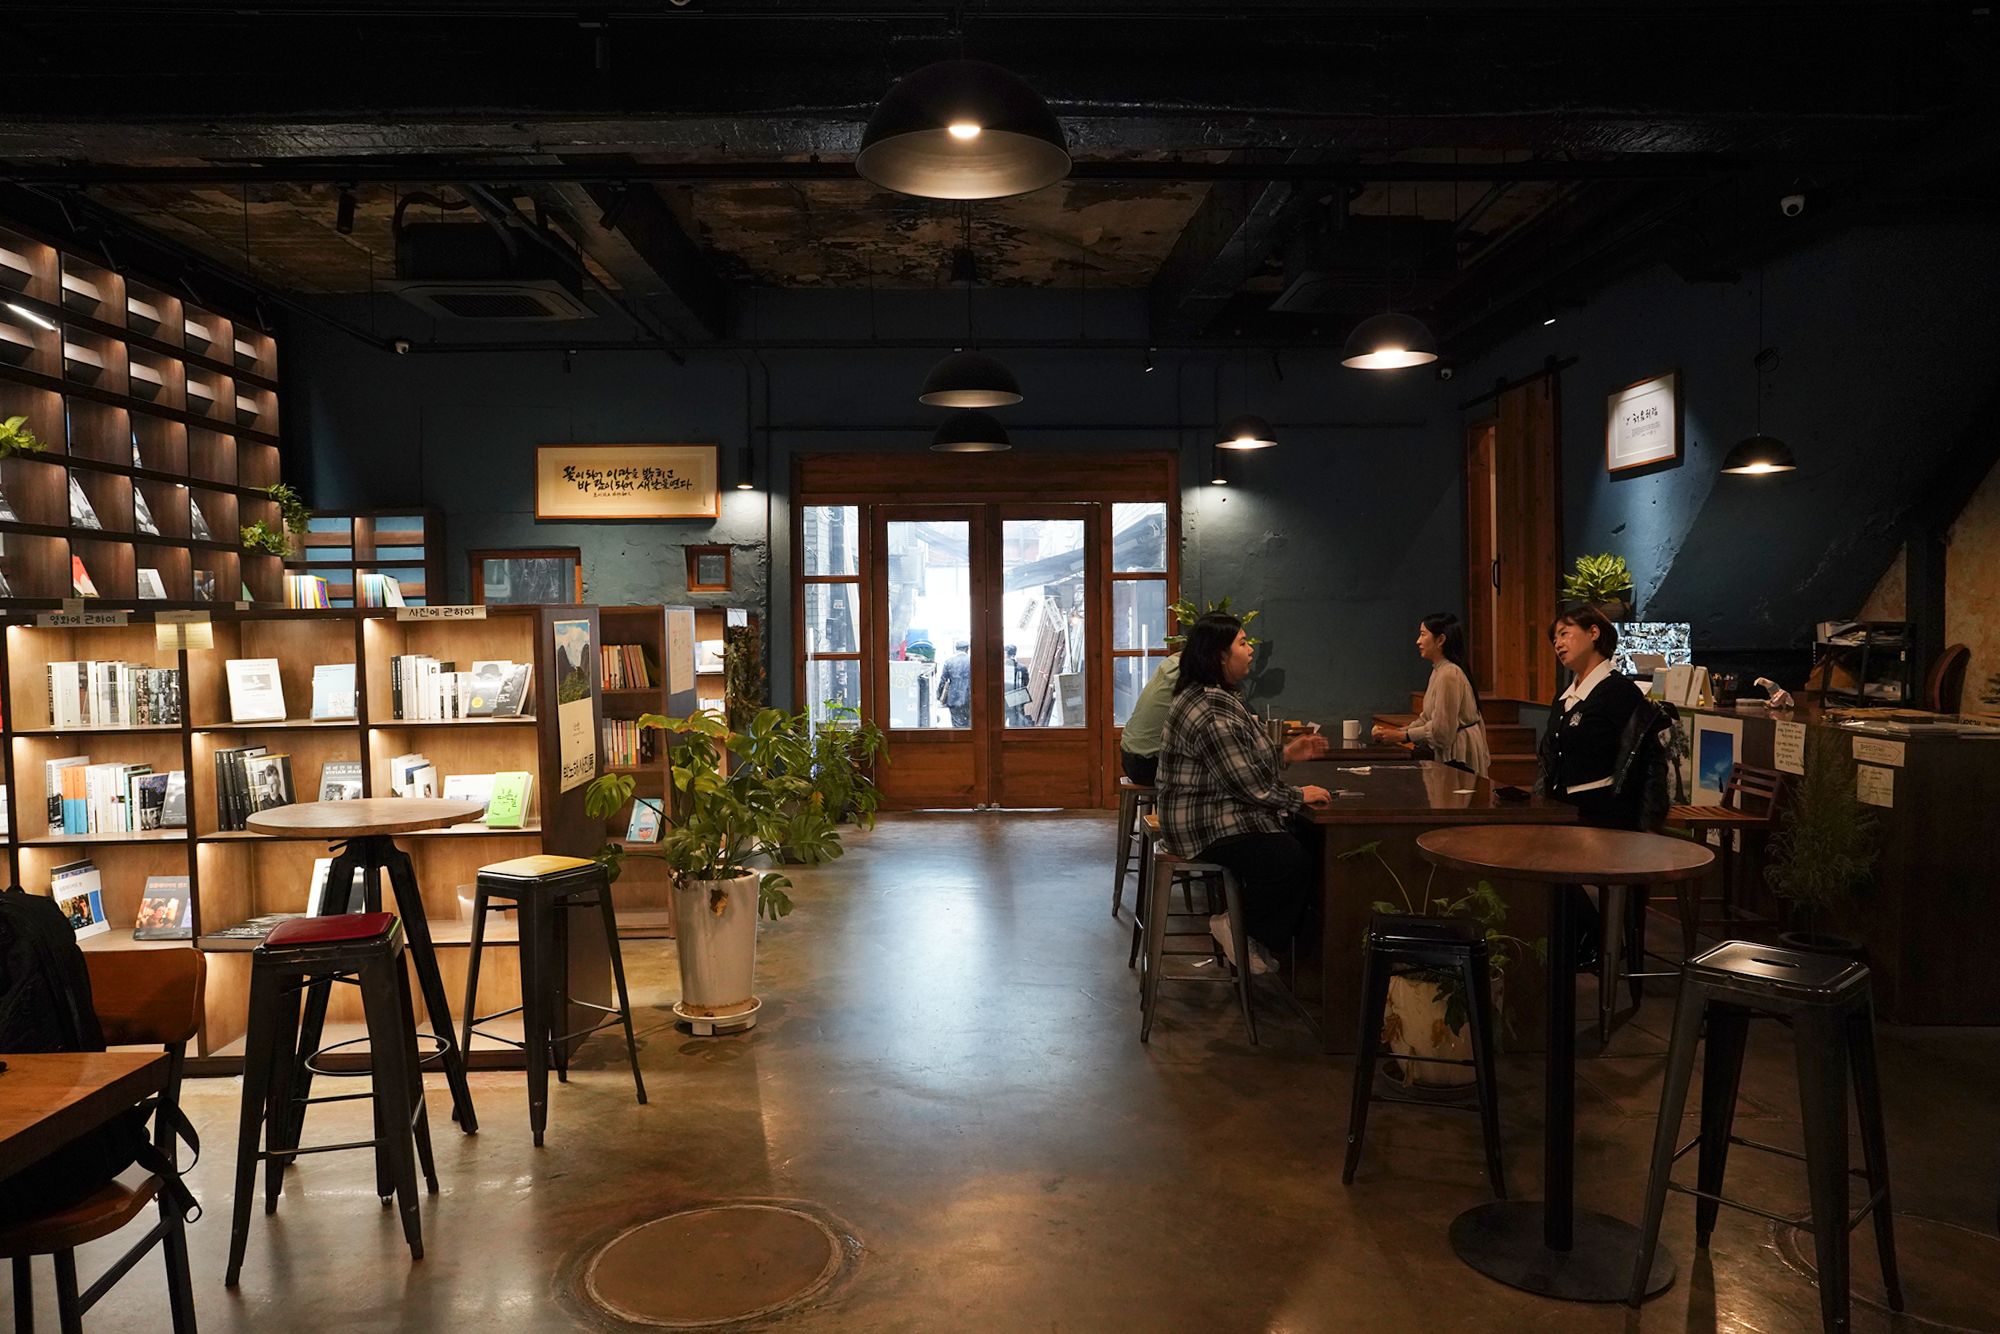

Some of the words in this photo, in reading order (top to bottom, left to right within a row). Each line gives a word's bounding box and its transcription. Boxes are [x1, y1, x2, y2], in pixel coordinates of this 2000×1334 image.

[409, 607, 440, 617] 사진에
[443, 607, 474, 617] 관하여
[50, 615, 81, 625] 영화에
[84, 614, 116, 625] 관하여
